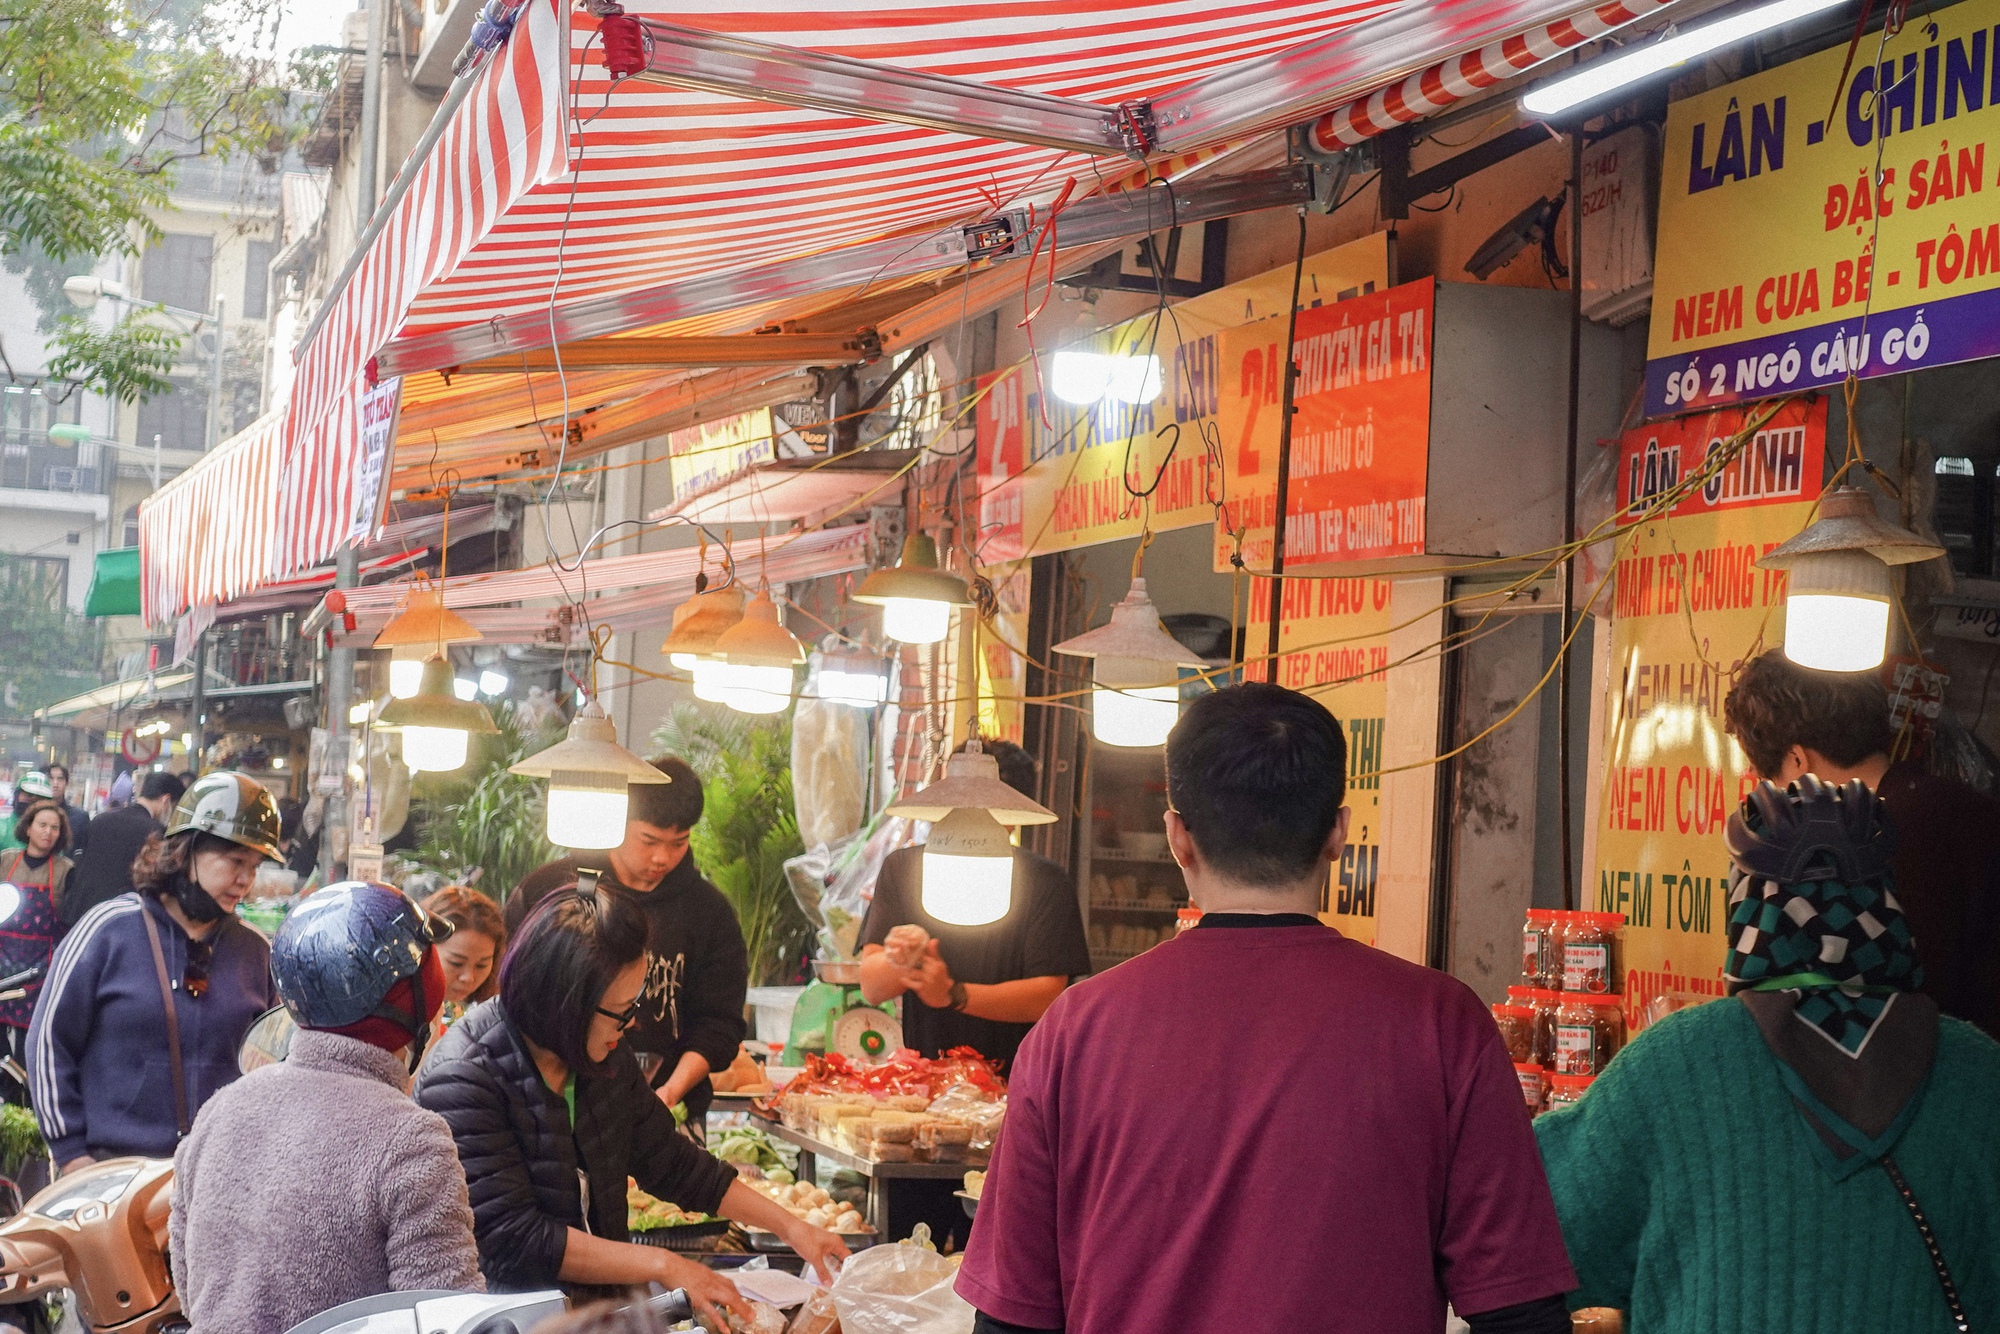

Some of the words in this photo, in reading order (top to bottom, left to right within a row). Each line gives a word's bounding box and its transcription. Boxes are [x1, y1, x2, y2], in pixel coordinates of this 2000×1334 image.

[1688, 96, 1787, 195] LÂN
[1823, 166, 1895, 236] ĐẶC
[1906, 139, 1985, 210] SẢN
[1672, 284, 1743, 343] NEM
[1755, 267, 1820, 324] CUA
[1831, 235, 1876, 308] BỂ
[1915, 223, 2000, 289] TÔM
[1366, 299, 1392, 382] GÀ
[1398, 308, 1425, 374] TA
[1664, 351, 1701, 405] SỐ
[1708, 363, 1727, 397] 2
[1734, 341, 1801, 393] NGÕ
[1810, 327, 1870, 378] CẦU
[1880, 308, 1930, 365] GỖ
[1237, 342, 1278, 477] 2A
[1323, 411, 1352, 474] NẤU
[1355, 406, 1374, 469] CỖ
[1628, 436, 1681, 517] LÂN
[1285, 498, 1317, 558] MẮM
[1318, 499, 1343, 553] TÉP
[1346, 498, 1393, 551] CHƯNG
[1396, 497, 1425, 553] THỊT
[1616, 535, 1654, 619] MẮM
[1691, 539, 1756, 613] CHƯNG
[1762, 542, 1787, 607] TH
[1315, 647, 1365, 686] CHƯNG
[1620, 664, 1671, 719] NEM
[1680, 637, 1720, 718] HẢI
[1609, 766, 1666, 832] NEM
[1675, 765, 1727, 835] CUA
[1600, 869, 1652, 928] NEM
[1662, 859, 1712, 934] TÔM
